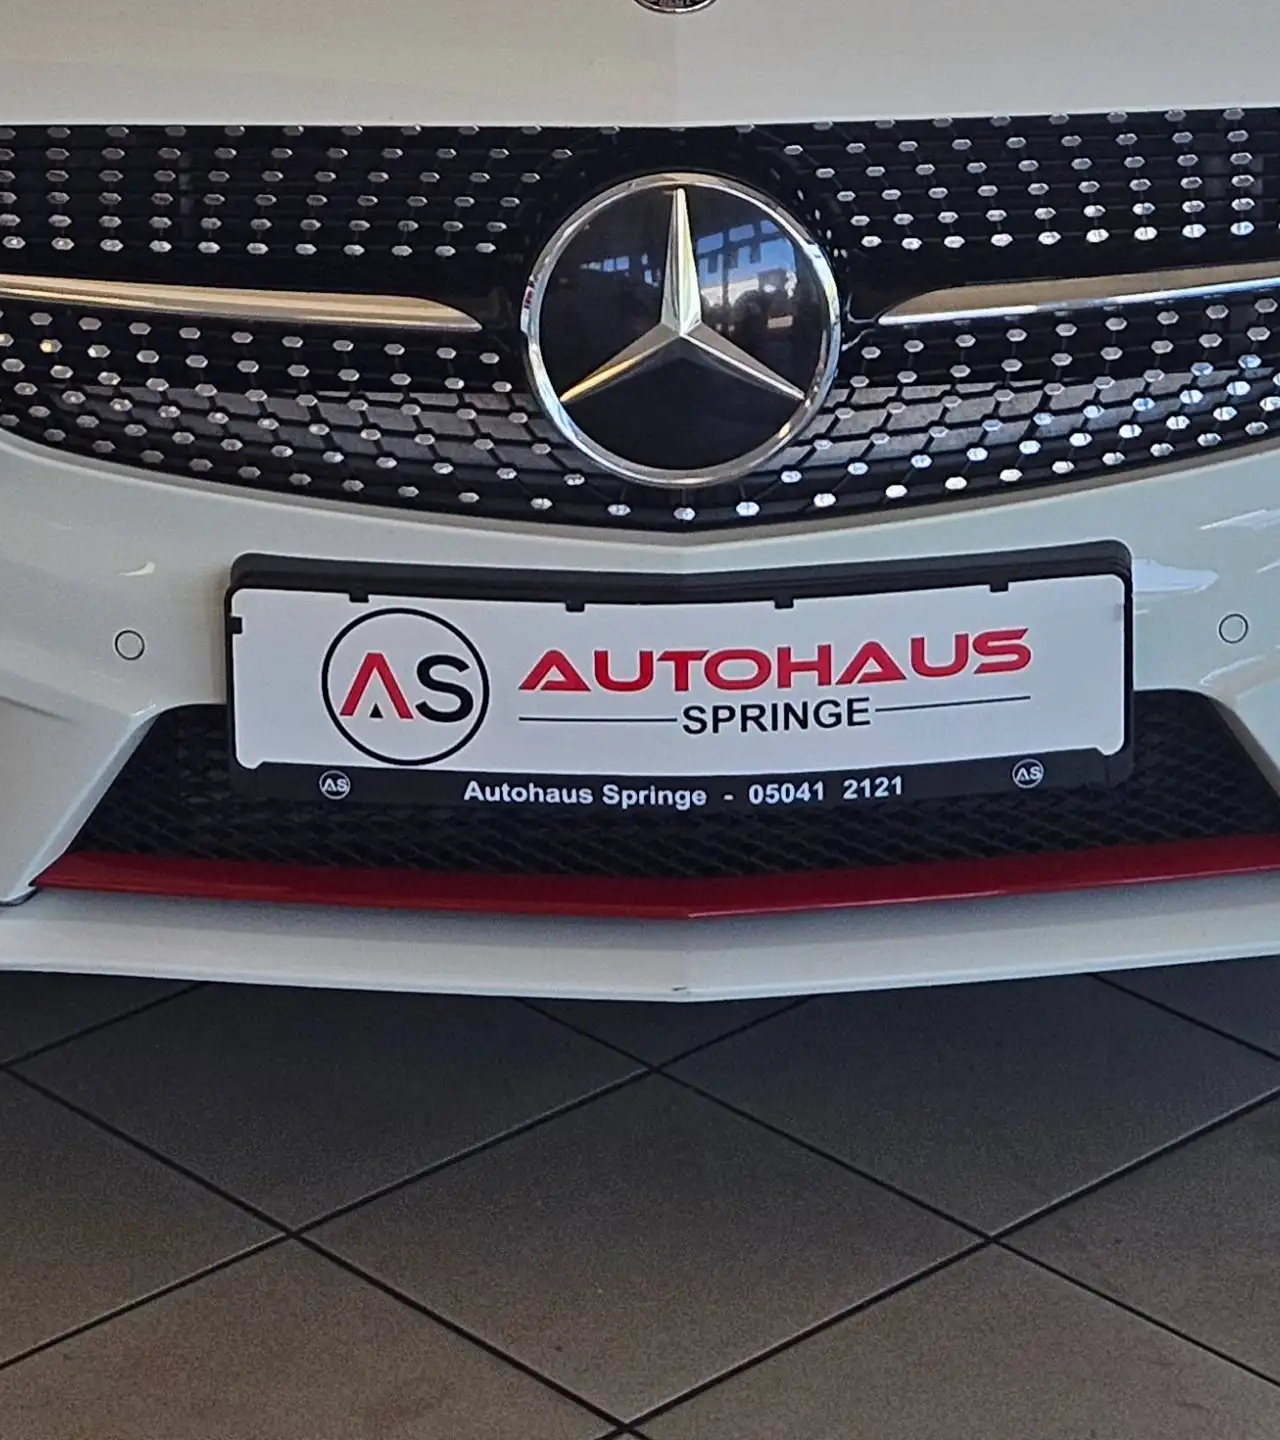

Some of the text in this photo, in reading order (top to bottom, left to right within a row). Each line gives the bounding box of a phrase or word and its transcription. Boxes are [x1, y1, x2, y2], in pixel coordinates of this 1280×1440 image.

[518, 627, 1032, 693] AUTOHAUS
[339, 652, 474, 723] AS
[682, 697, 871, 735] SPRINGE
[463, 780, 594, 805] Autohaus
[602, 784, 708, 811] Springe
[748, 781, 825, 805] 05041
[842, 775, 903, 800] 2121
